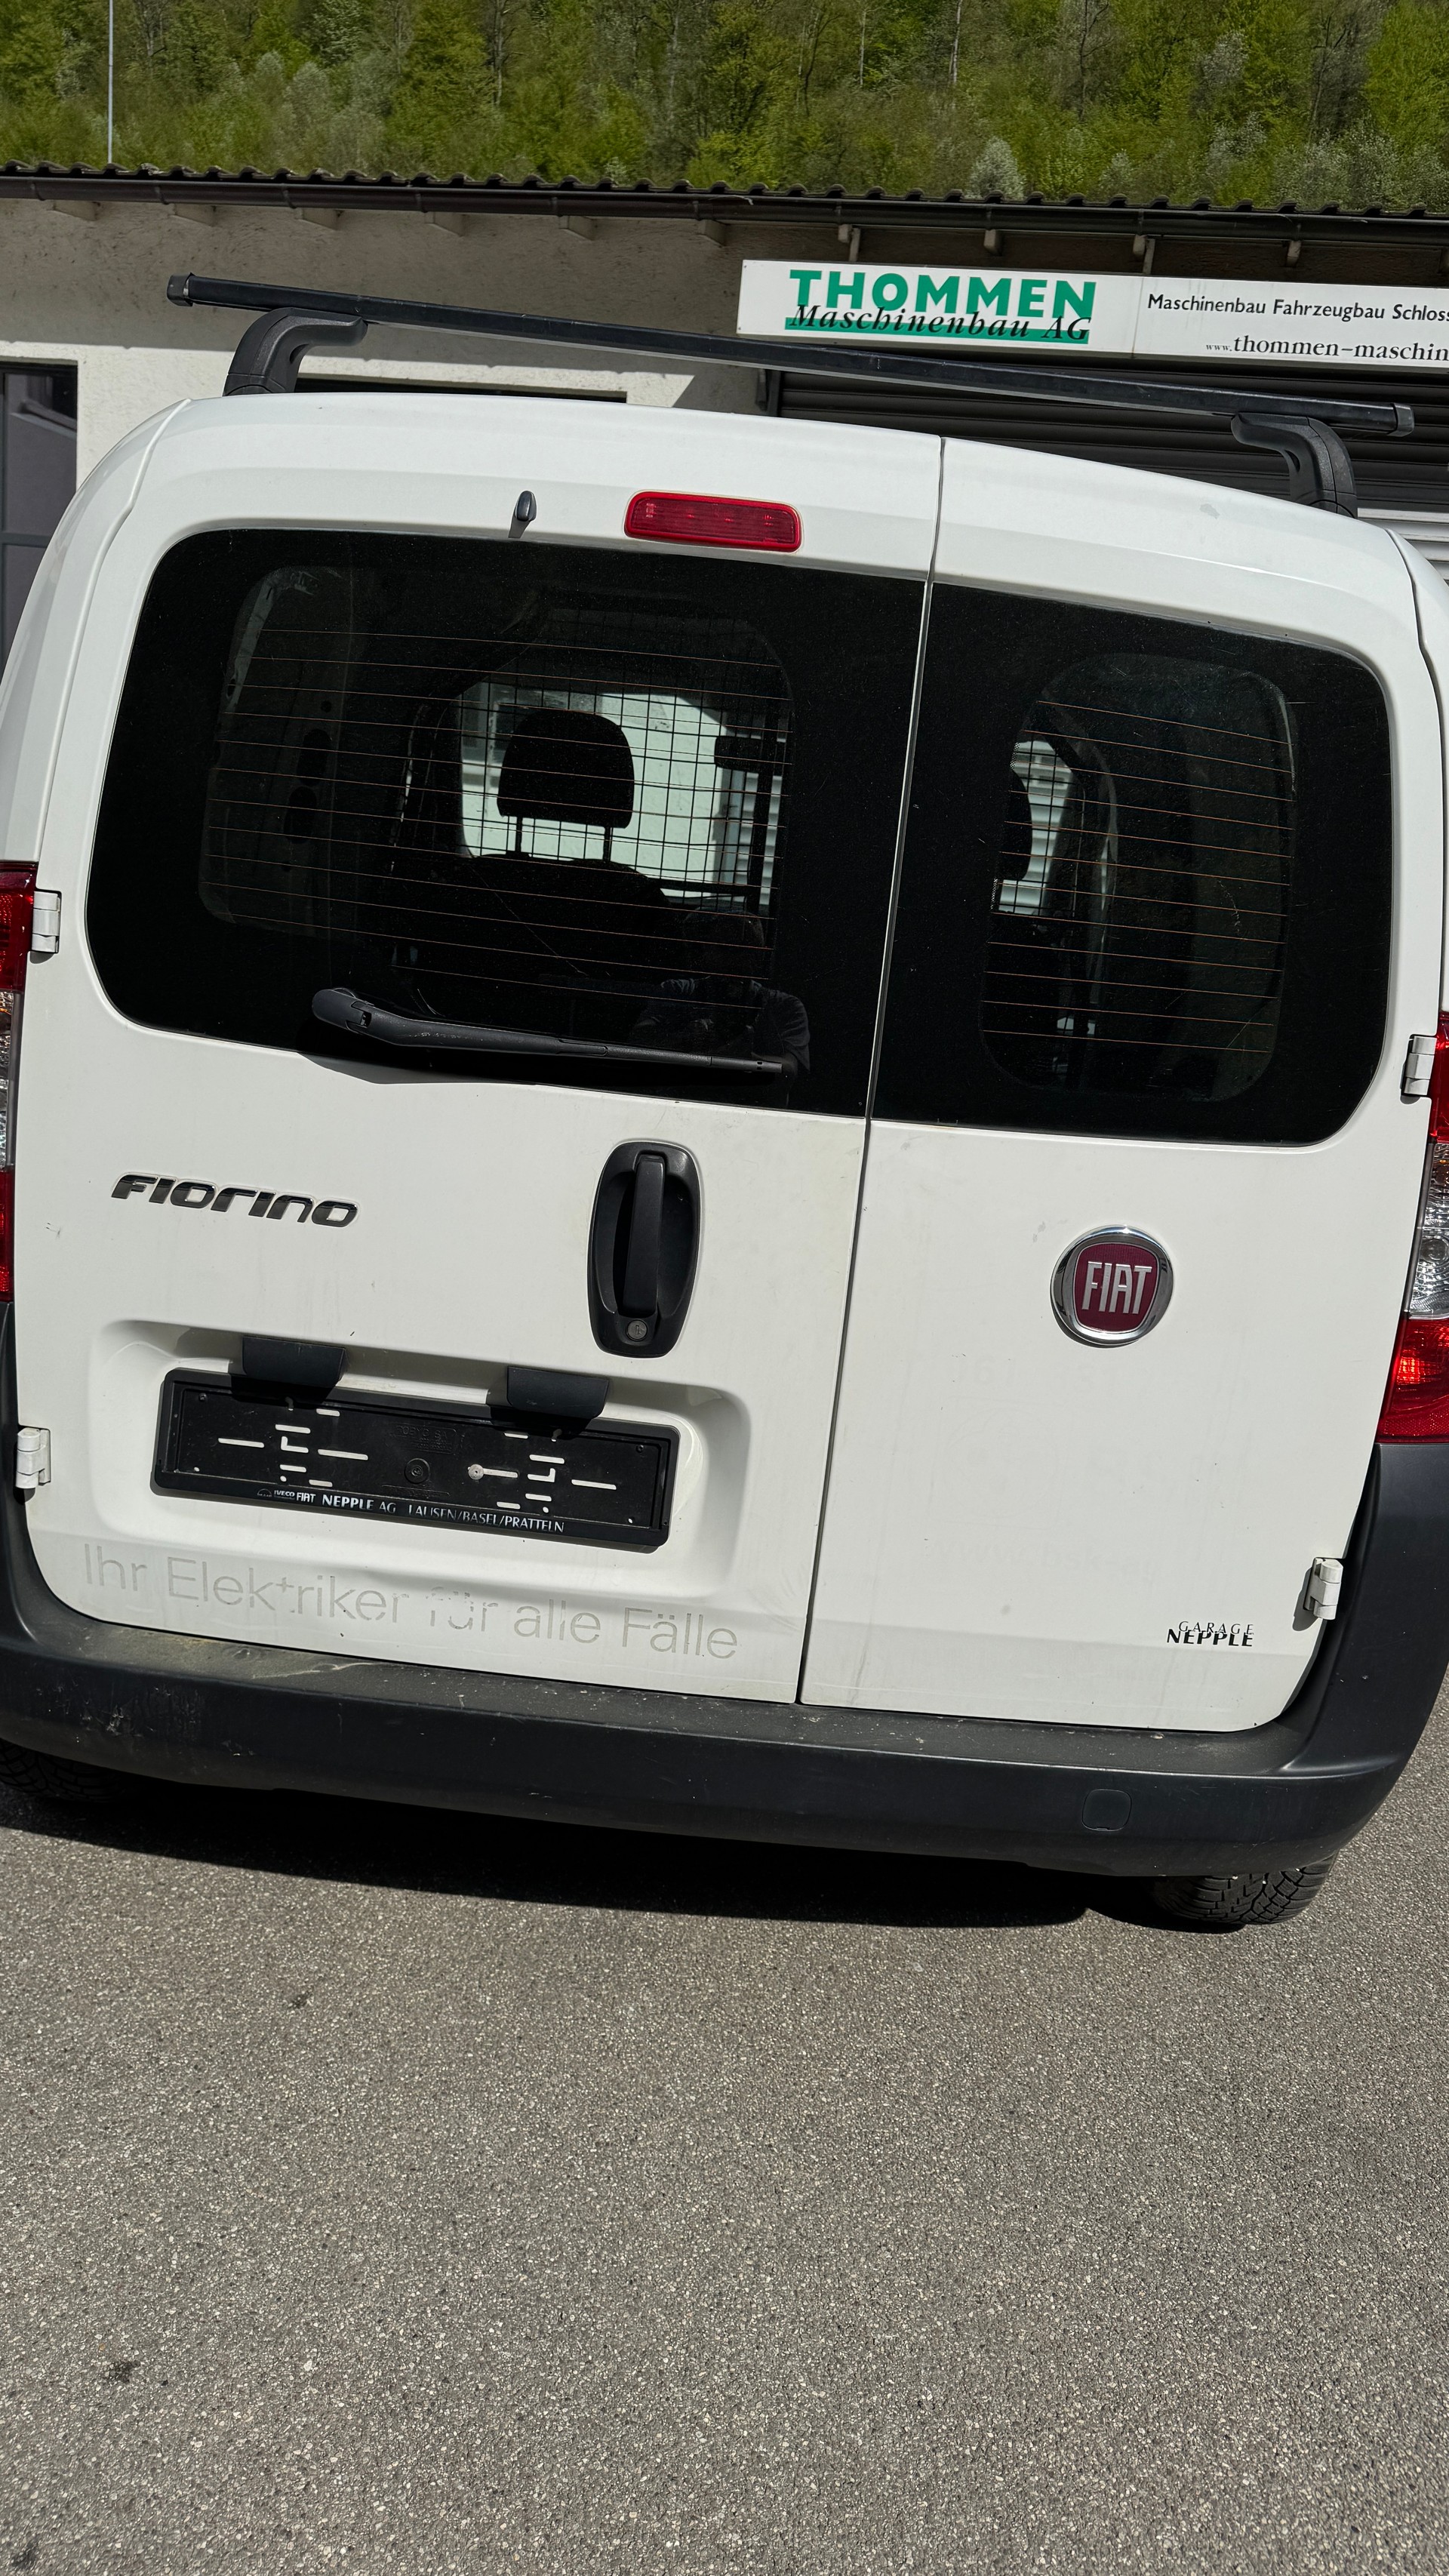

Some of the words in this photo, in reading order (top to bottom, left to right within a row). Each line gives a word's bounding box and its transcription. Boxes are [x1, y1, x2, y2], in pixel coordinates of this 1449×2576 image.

[789, 269, 1097, 319] THOMMEN
[1147, 294, 1266, 315] Maschinenbau
[1273, 299, 1385, 322] Fahrzeugbau
[789, 304, 1029, 337] Maschinenbau
[1041, 315, 1092, 340] AG
[1205, 335, 1449, 362] www.thommen-maschin
[1081, 1261, 1152, 1315] FIAT
[297, 1491, 316, 1503] FIAT
[322, 1494, 374, 1510] NEPPLE
[379, 1500, 396, 1514] AG
[84, 1543, 147, 1592] Ihr
[167, 1556, 410, 1623] Elektriker
[513, 1599, 601, 1644] alle
[622, 1607, 738, 1660] Fälle
[1167, 1629, 1254, 1647] NEPPLE
[1179, 1620, 1254, 1635] GARAGE
